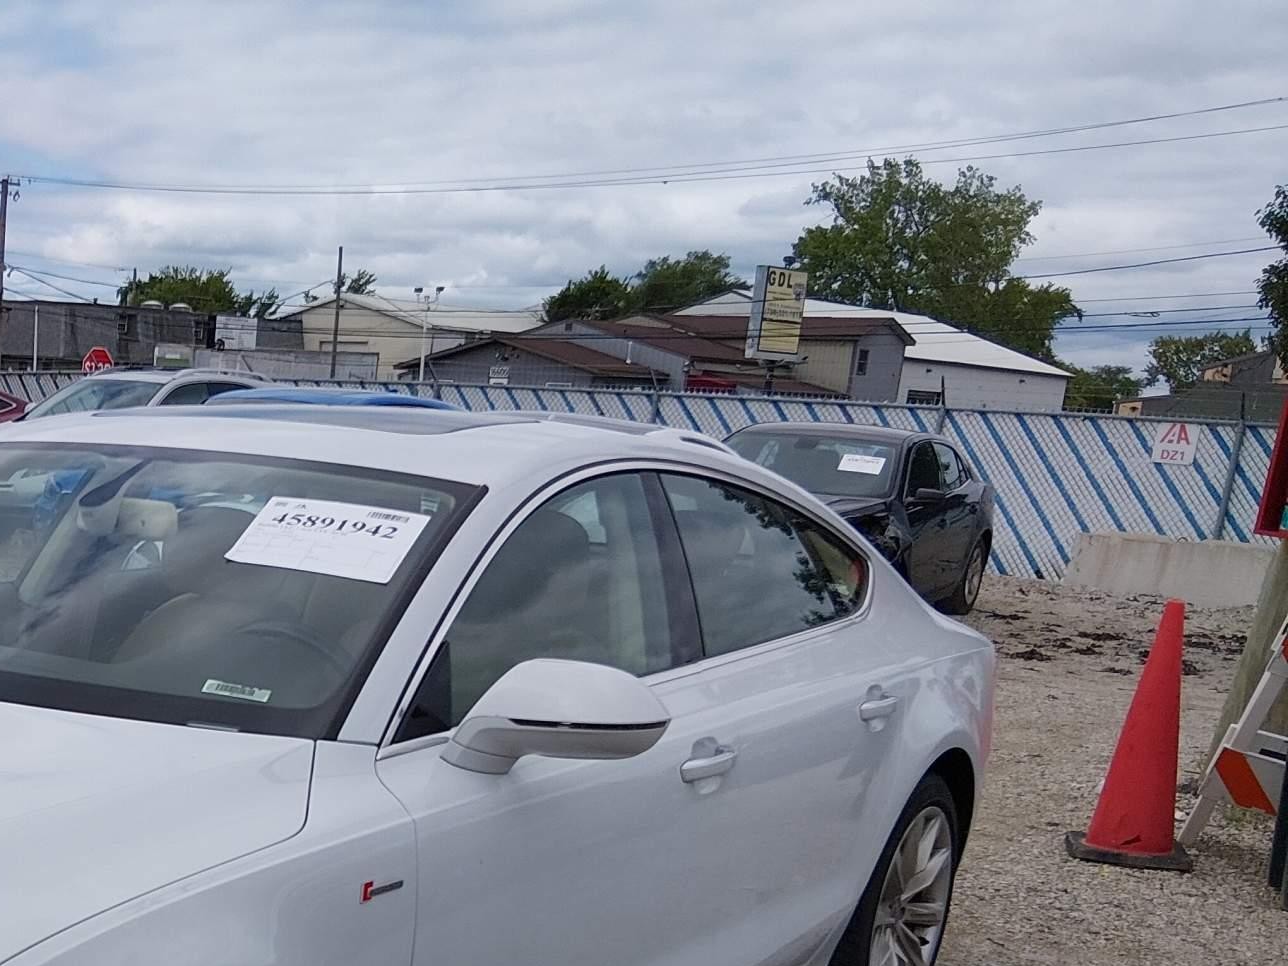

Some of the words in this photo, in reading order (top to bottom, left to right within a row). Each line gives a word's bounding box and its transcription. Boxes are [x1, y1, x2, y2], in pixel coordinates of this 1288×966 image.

[768, 270, 793, 289] GDL
[1160, 449, 1185, 461] DZ1
[271, 512, 399, 540] 45891942
